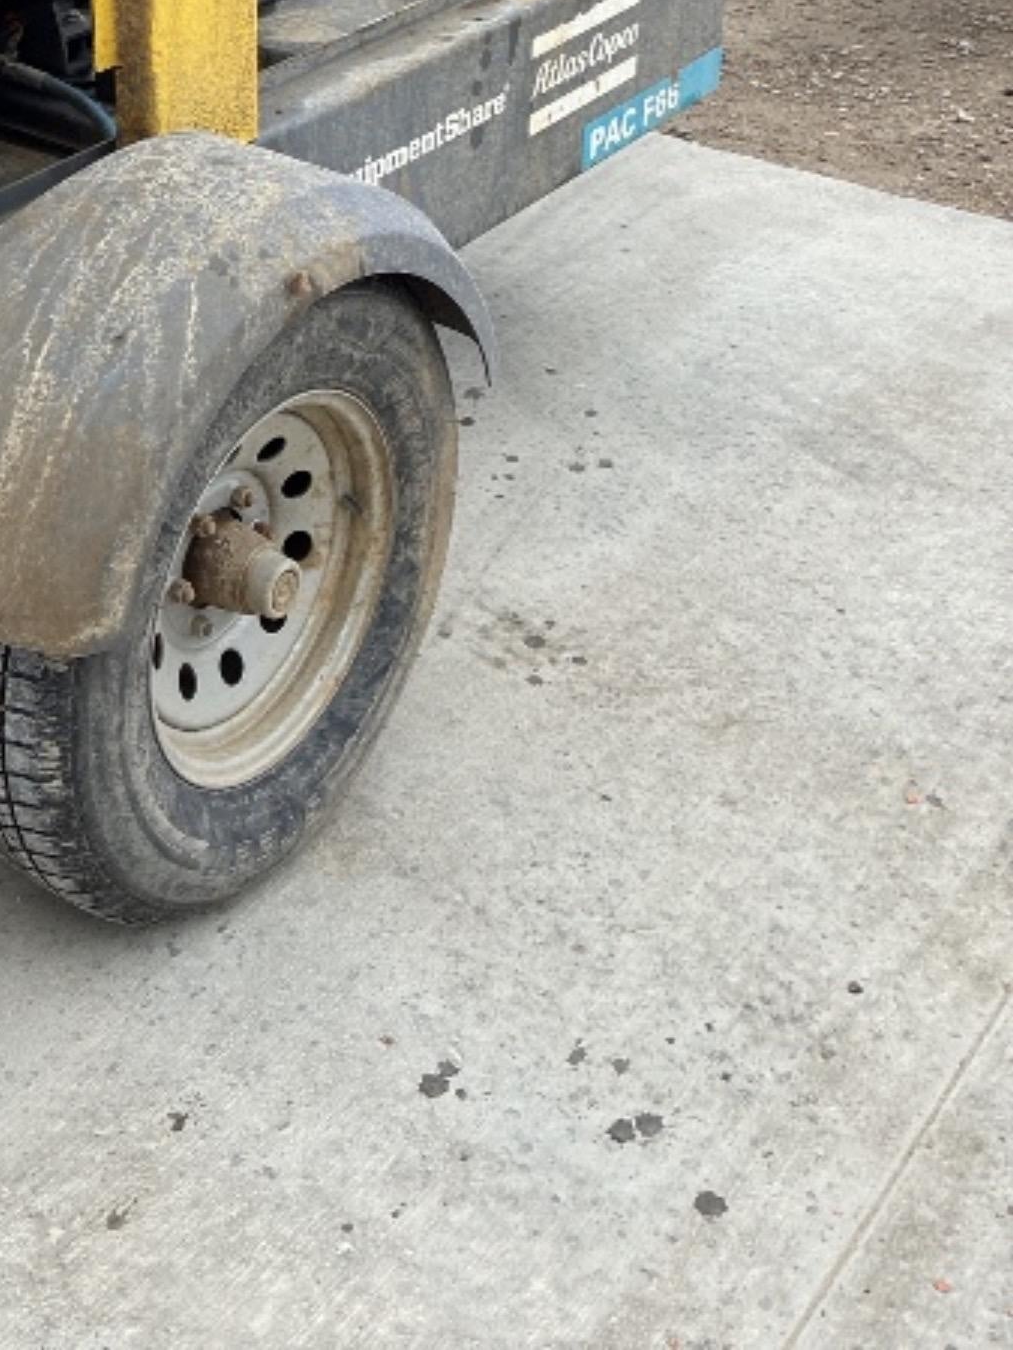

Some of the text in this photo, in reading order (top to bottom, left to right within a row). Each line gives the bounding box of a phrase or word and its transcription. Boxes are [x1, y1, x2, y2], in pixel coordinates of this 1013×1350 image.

[531, 51, 589, 99] Atlas
[349, 91, 507, 186] ipmentShare
[589, 107, 637, 159] PAC
